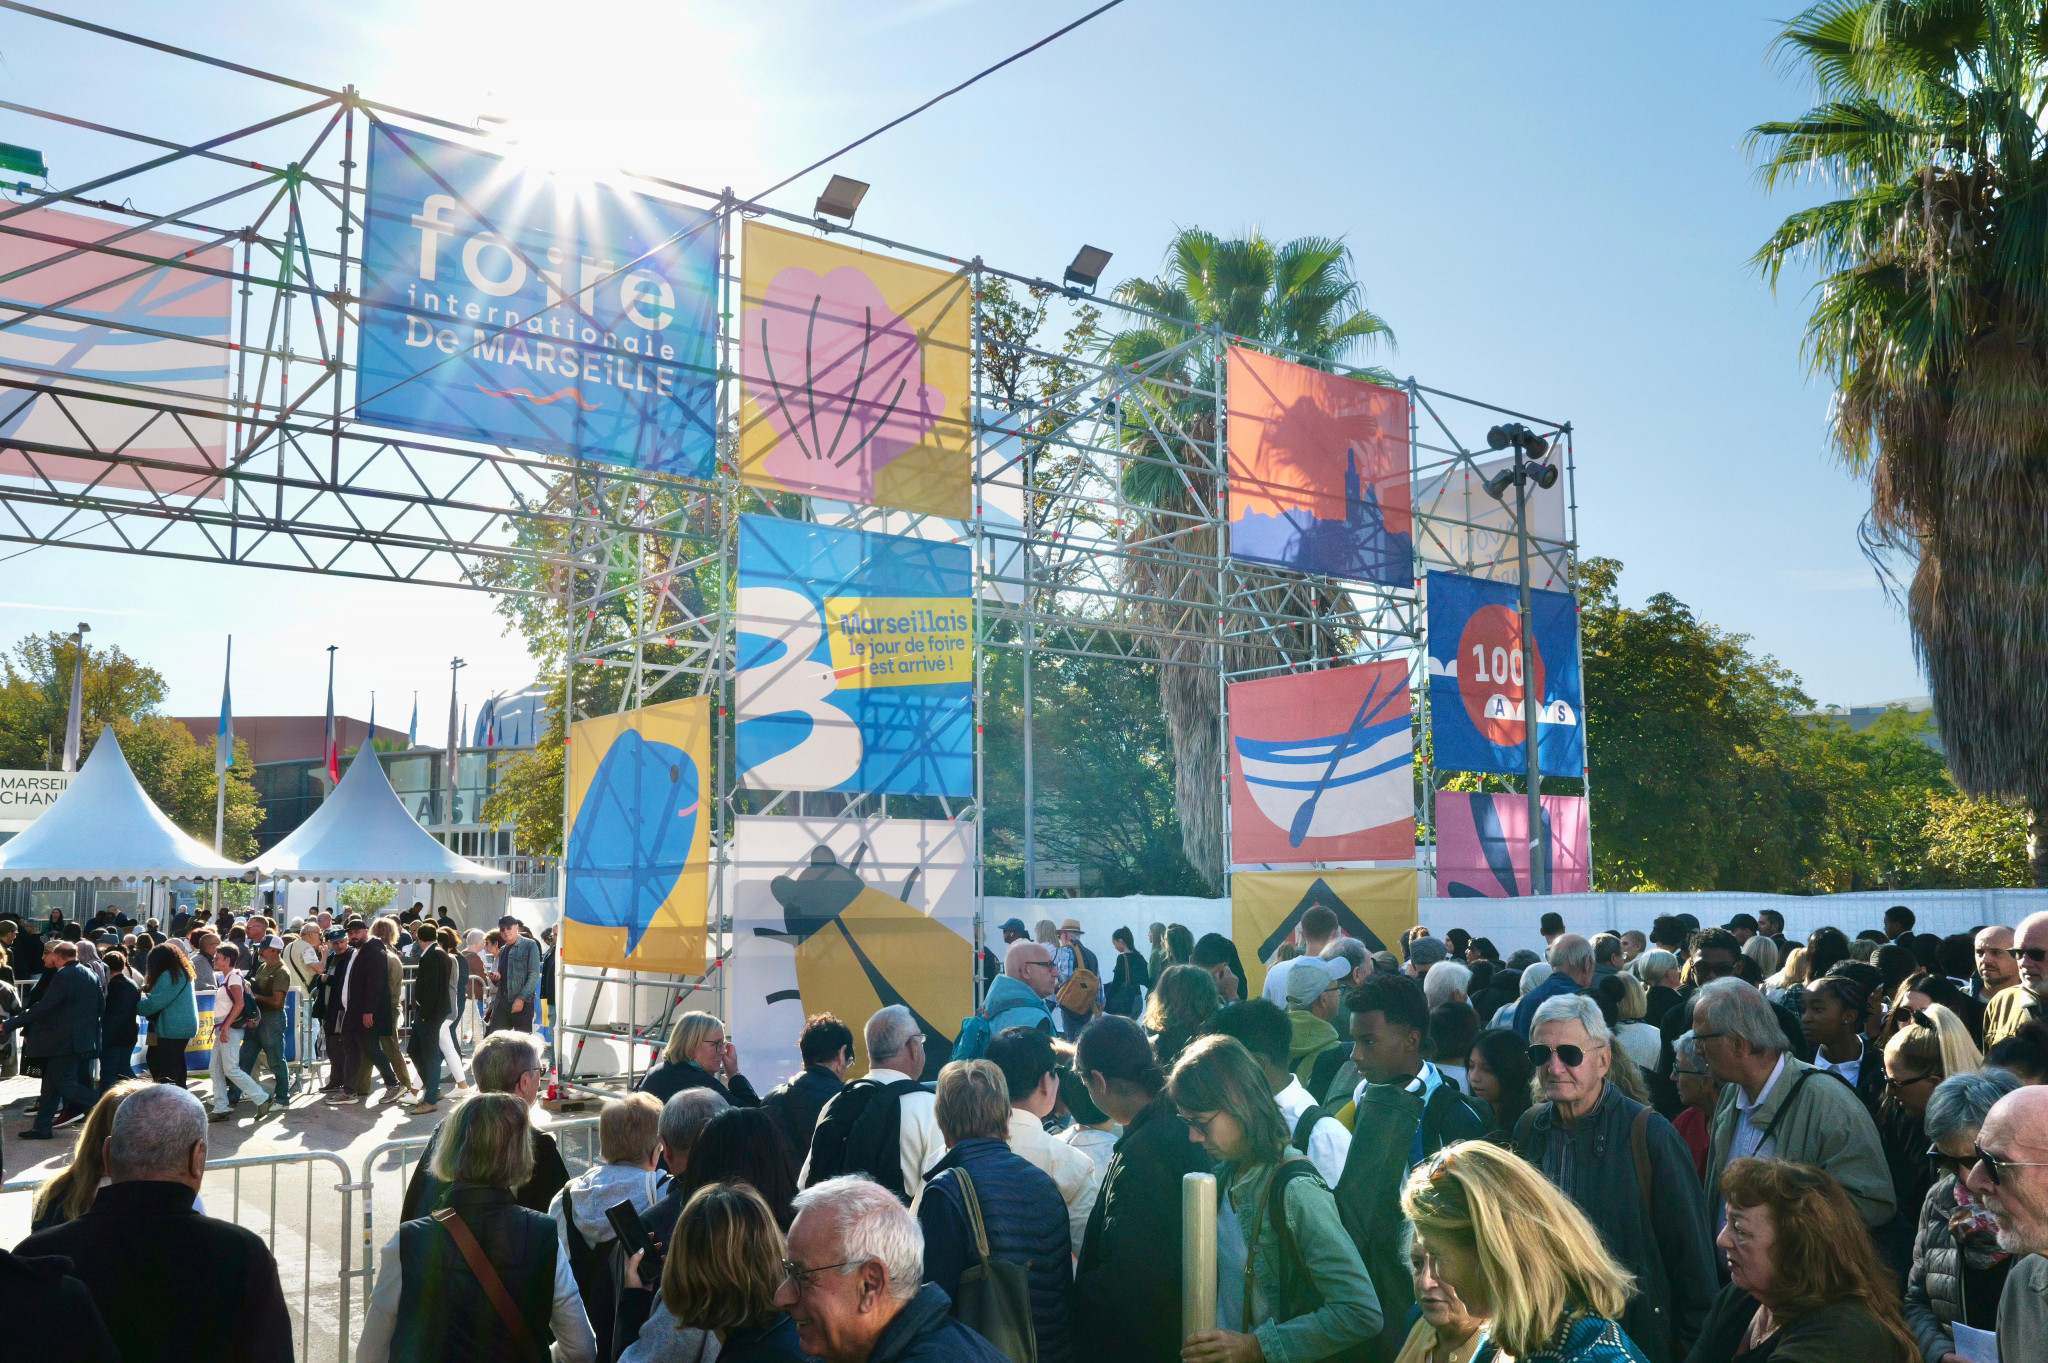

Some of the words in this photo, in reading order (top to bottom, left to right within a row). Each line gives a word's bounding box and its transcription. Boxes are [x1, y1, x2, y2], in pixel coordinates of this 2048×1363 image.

[411, 194, 675, 331] foire
[405, 315, 459, 354] De
[407, 284, 674, 360] internationale
[840, 609, 968, 636] Marseillais
[849, 639, 865, 656] le
[869, 638, 900, 659] jour
[904, 636, 925, 654] de
[927, 635, 965, 652] foire
[869, 660, 894, 675] est
[898, 655, 946, 673] arrivé
[948, 655, 954, 671] !
[1472, 644, 1524, 686] 100
[1494, 698, 1566, 722] AS
[1, 777, 67, 790] MARSEIL
[0, 791, 58, 805] CHAN
